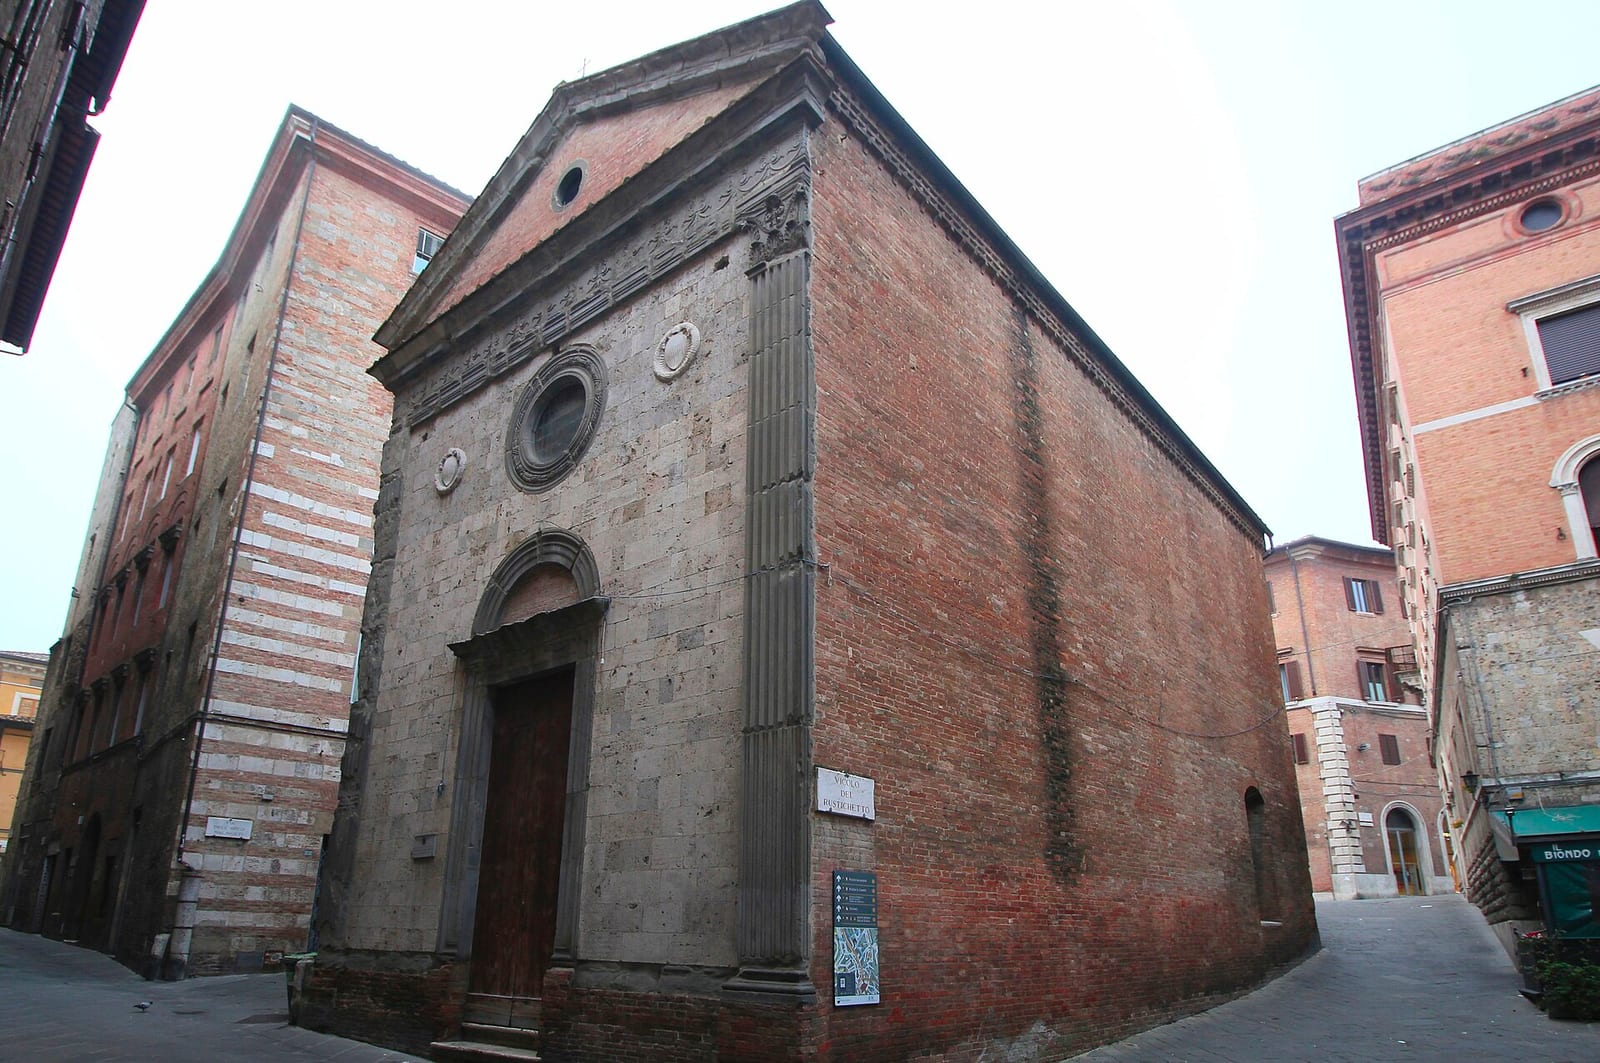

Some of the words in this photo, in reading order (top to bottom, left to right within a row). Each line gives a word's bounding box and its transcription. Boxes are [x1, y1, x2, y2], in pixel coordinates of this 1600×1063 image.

[834, 775, 860, 789] VICOLO
[823, 798, 870, 814] RUSTICHETTO
[1544, 849, 1591, 860] BIONDO
